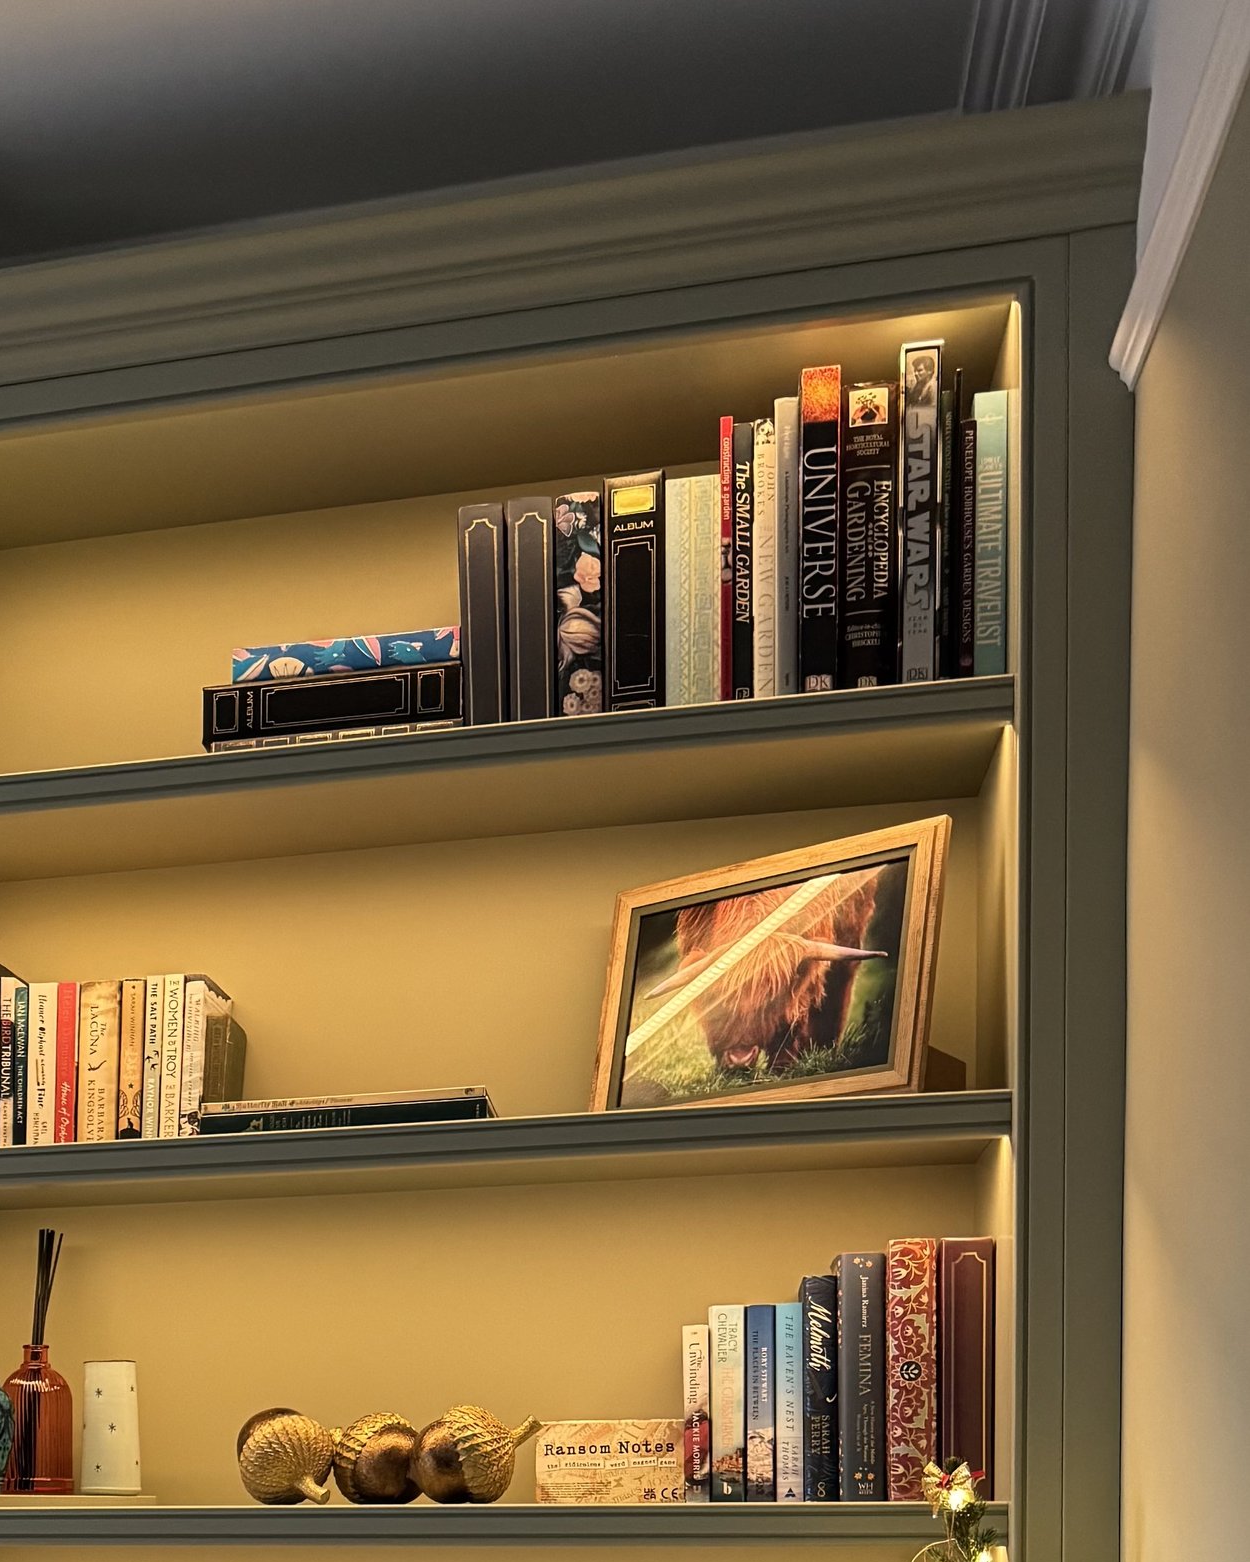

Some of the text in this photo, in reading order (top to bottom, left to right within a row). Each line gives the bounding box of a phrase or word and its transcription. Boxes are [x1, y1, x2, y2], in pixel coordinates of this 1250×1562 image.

[722, 437, 732, 484] constructing
[766, 464, 774, 501] JOHN
[613, 520, 654, 533] ALBUM
[722, 493, 731, 520] garden
[907, 411, 931, 611] STAR WARS
[977, 471, 1003, 552] ULTIMATE
[735, 461, 750, 623] The SMALL GARDEN
[803, 444, 837, 618] UNIVERSE
[846, 481, 871, 601] GARDENING
[873, 480, 892, 599] ENCYCLOPEDIA
[962, 430, 974, 644] PENELOPE HOBHOUSE'S GARDEN DESIGNS
[759, 535, 773, 585] NEW
[976, 556, 1002, 645] TRAVELIST
[758, 593, 773, 692] GARDEN
[806, 675, 832, 690] DK
[858, 676, 877, 688] DK
[907, 668, 928, 681] DK
[246, 691, 254, 729] ALBUM
[16, 1001, 26, 1058] IAN McEWAN
[37, 994, 47, 1056] Eleanor Oliphant
[89, 1004, 99, 1056] LACUNA
[149, 983, 158, 1044] THE SALT PATH
[167, 987, 179, 1038] WOMEN
[193, 998, 201, 1042] WALKING
[0, 998, 12, 1100] THE BIRD TRIBUNAL
[166, 1047, 177, 1079] TROY
[37, 1088, 46, 1109] Fine
[58, 1107, 70, 1116] of
[60, 1082, 71, 1106] House
[97, 1088, 105, 1141] BARBARA
[146, 1078, 155, 1113] RAYNOR
[163, 1093, 176, 1138] BARKER
[860, 1275, 869, 1328] Janina Ramirez
[717, 1313, 728, 1363] CHEVALIER
[728, 1323, 737, 1353] TRACY
[808, 1295, 832, 1371] Melmoth
[688, 1342, 699, 1404] Unwinding
[721, 1367, 734, 1385] THE
[752, 1375, 759, 1383] IN
[785, 1316, 795, 1431] THE RAVEN'S NEST
[859, 1334, 872, 1396] FEMINA
[544, 1440, 675, 1457] Ransom Notes
[691, 1411, 700, 1481] JACKIE MORRIS
[811, 1416, 820, 1455] PERRY
[821, 1415, 830, 1454] SARAH
[659, 1459, 676, 1467] game
[781, 1441, 790, 1481] THOMAS
[791, 1445, 799, 1476] SARAH
[661, 1487, 679, 1500] CE
